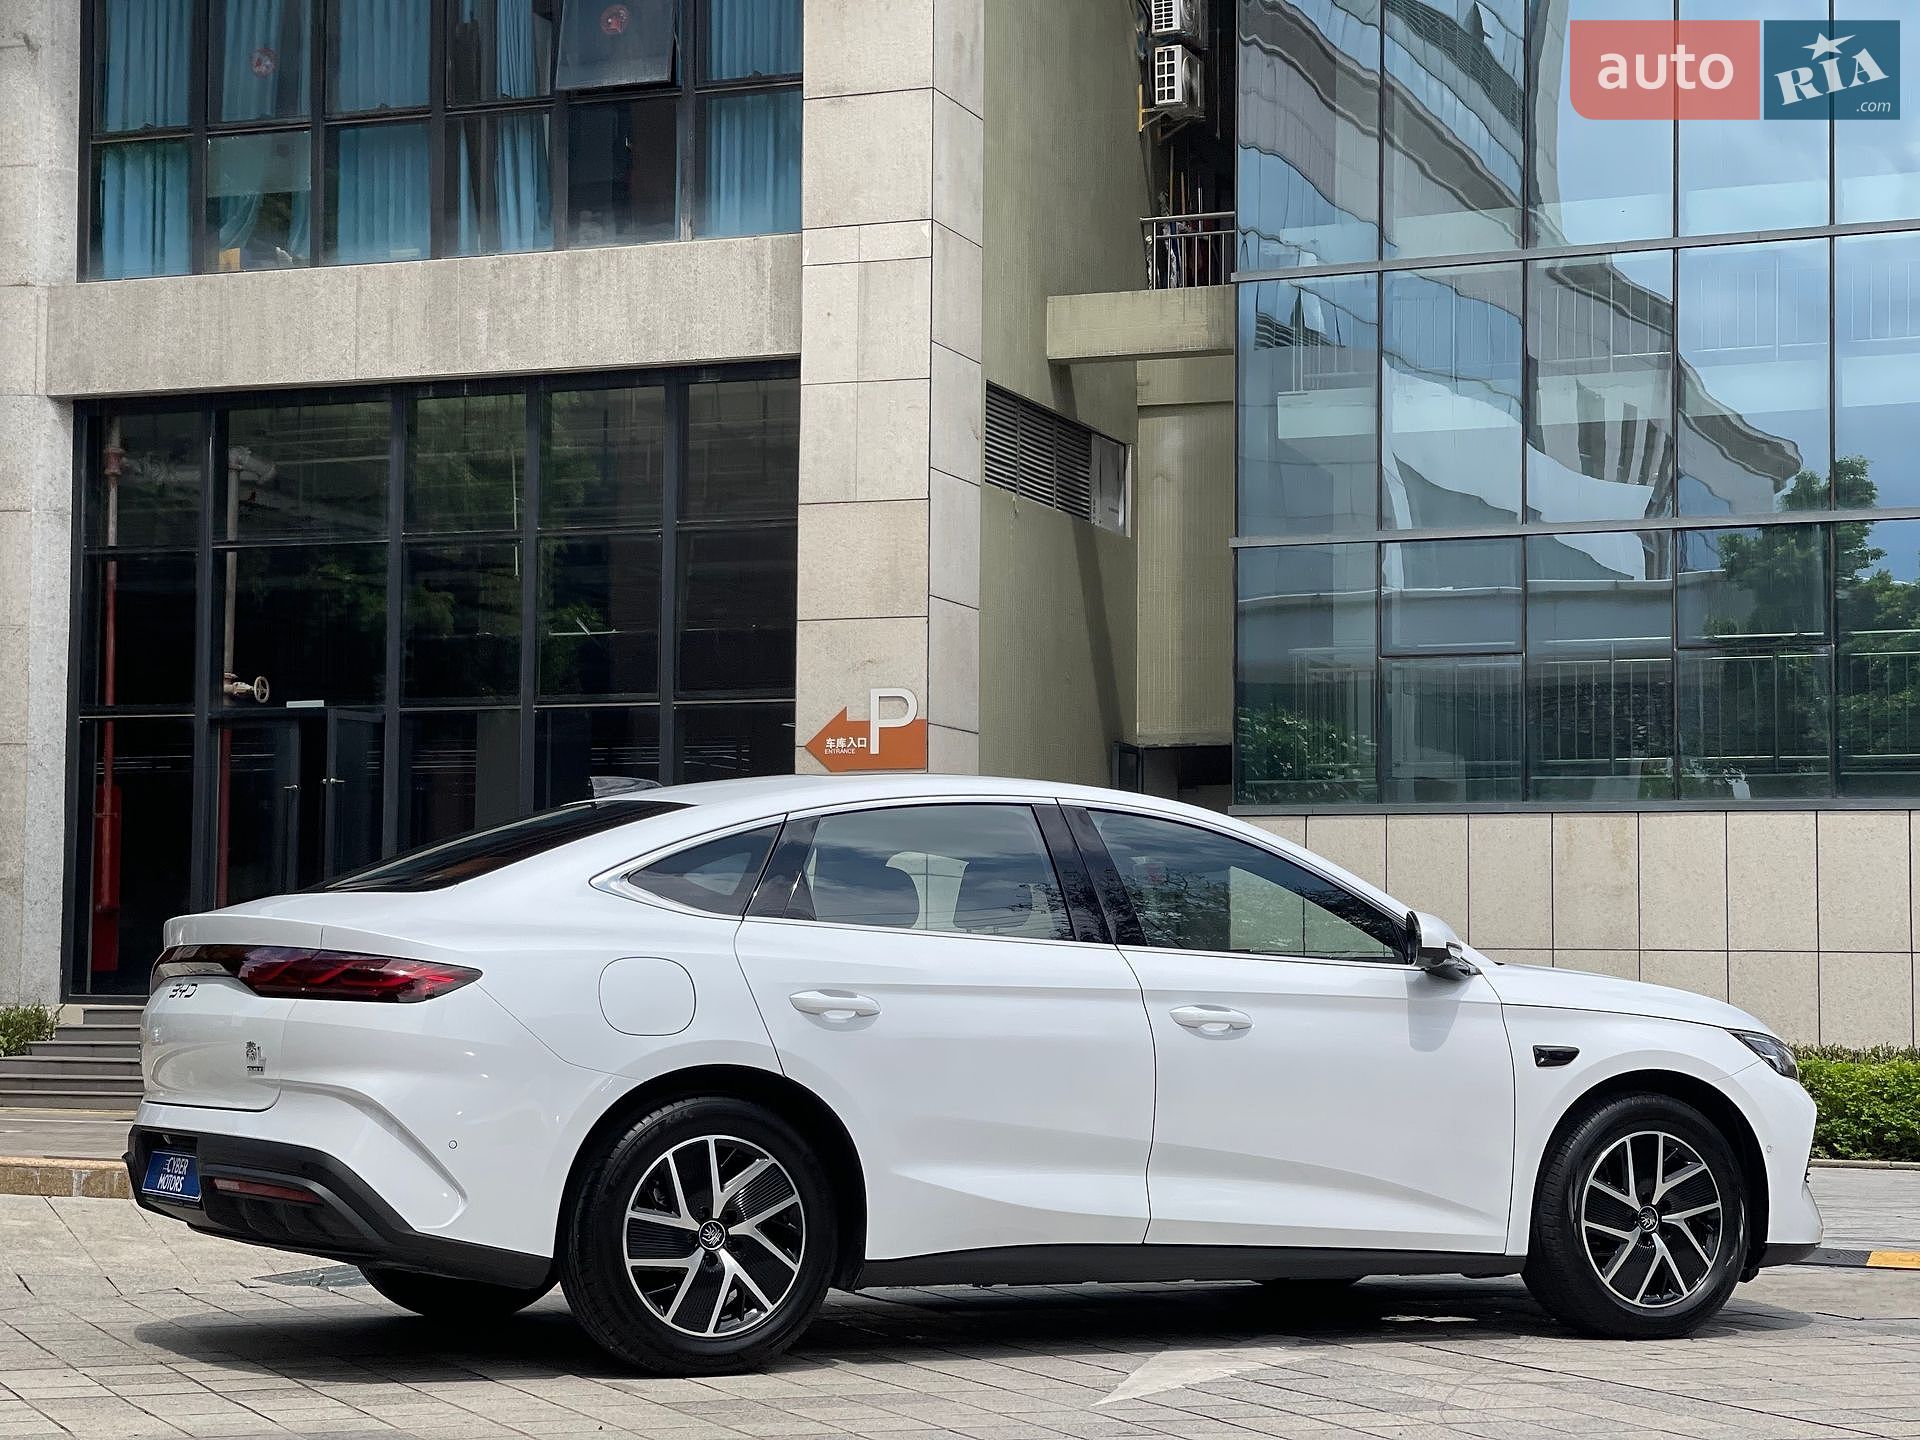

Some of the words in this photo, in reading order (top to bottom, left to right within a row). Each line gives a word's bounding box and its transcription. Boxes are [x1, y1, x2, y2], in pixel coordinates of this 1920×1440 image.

[870, 688, 918, 754] P
[826, 737, 867, 749] 车库入口
[168, 983, 198, 998] BYD
[167, 1157, 188, 1175] CYBER
[158, 1174, 184, 1192] MOTORS
